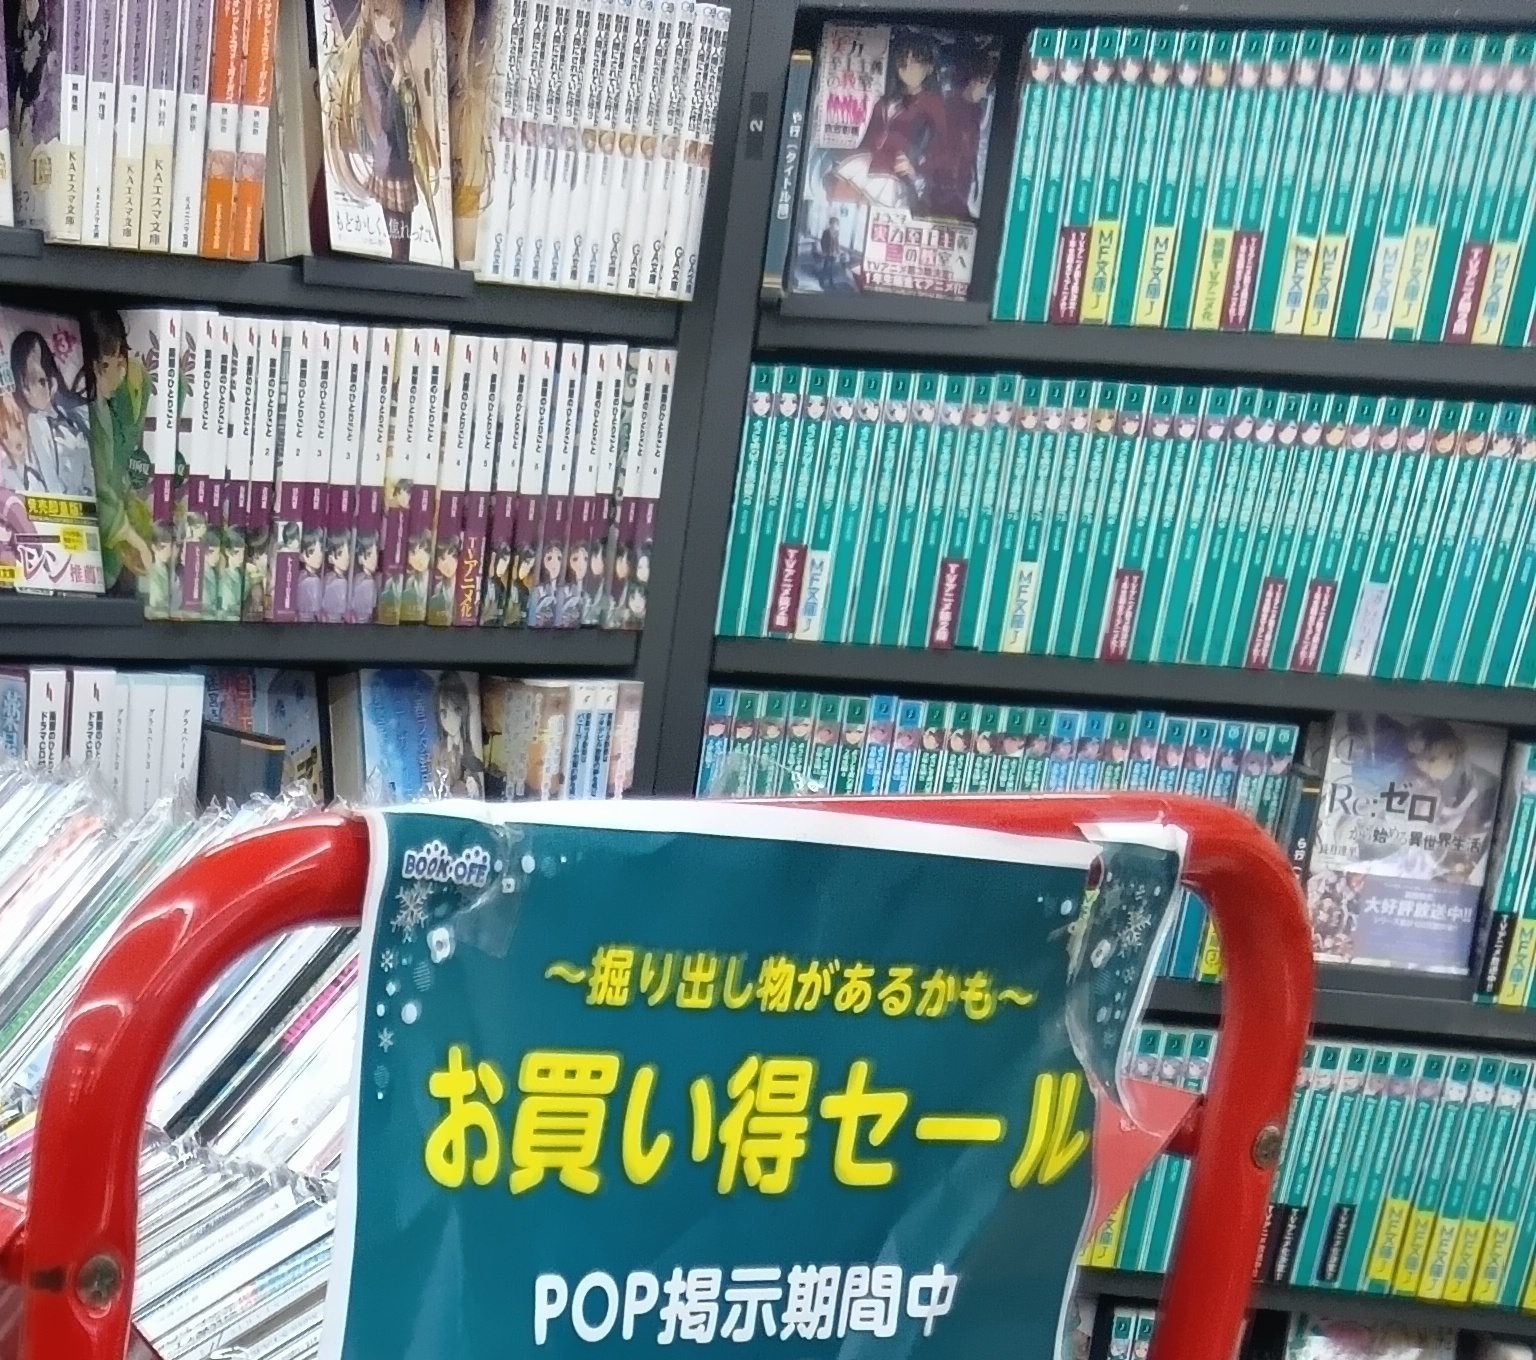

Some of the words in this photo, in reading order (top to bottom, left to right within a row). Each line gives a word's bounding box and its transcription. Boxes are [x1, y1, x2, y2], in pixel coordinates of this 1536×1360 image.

[66, 151, 76, 225] KAエスマ文庫
[149, 159, 163, 245] KAエスマ文庫
[424, 1046, 1089, 1196] お買い得セール
[535, 1264, 958, 1346] POP掲示期間中
